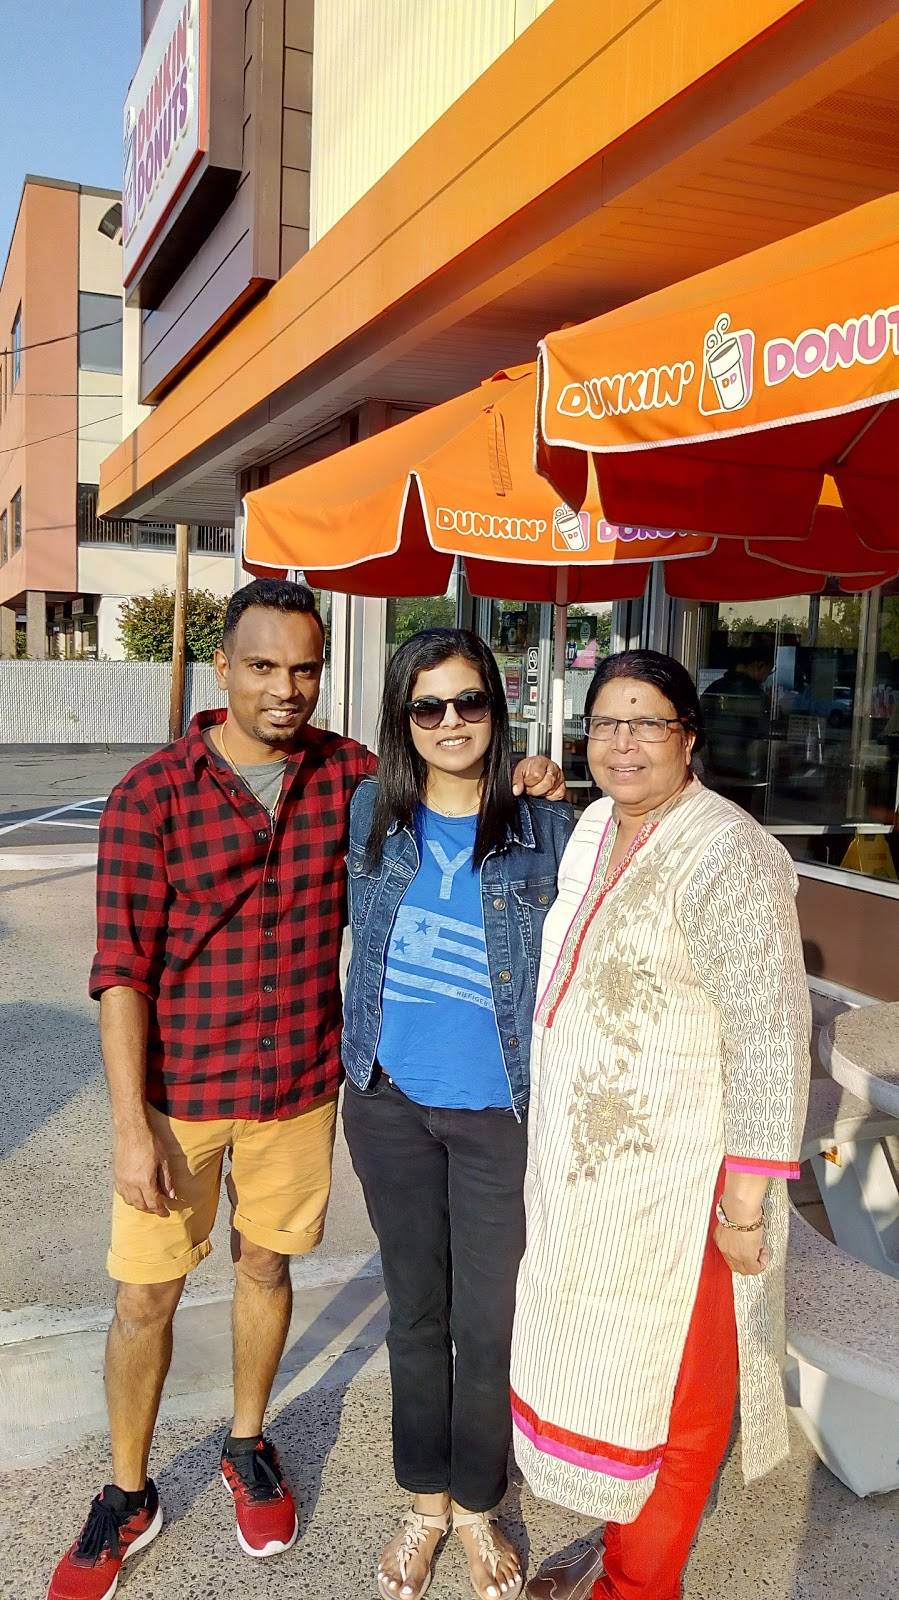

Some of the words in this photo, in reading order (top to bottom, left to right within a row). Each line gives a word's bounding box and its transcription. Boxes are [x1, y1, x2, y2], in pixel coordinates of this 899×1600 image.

[137, 66, 189, 214] DONUTS
[556, 361, 695, 419] DUNKIN'
[722, 372, 737, 388] DD
[436, 507, 547, 542] DUNKIN'
[425, 839, 474, 900] Y
